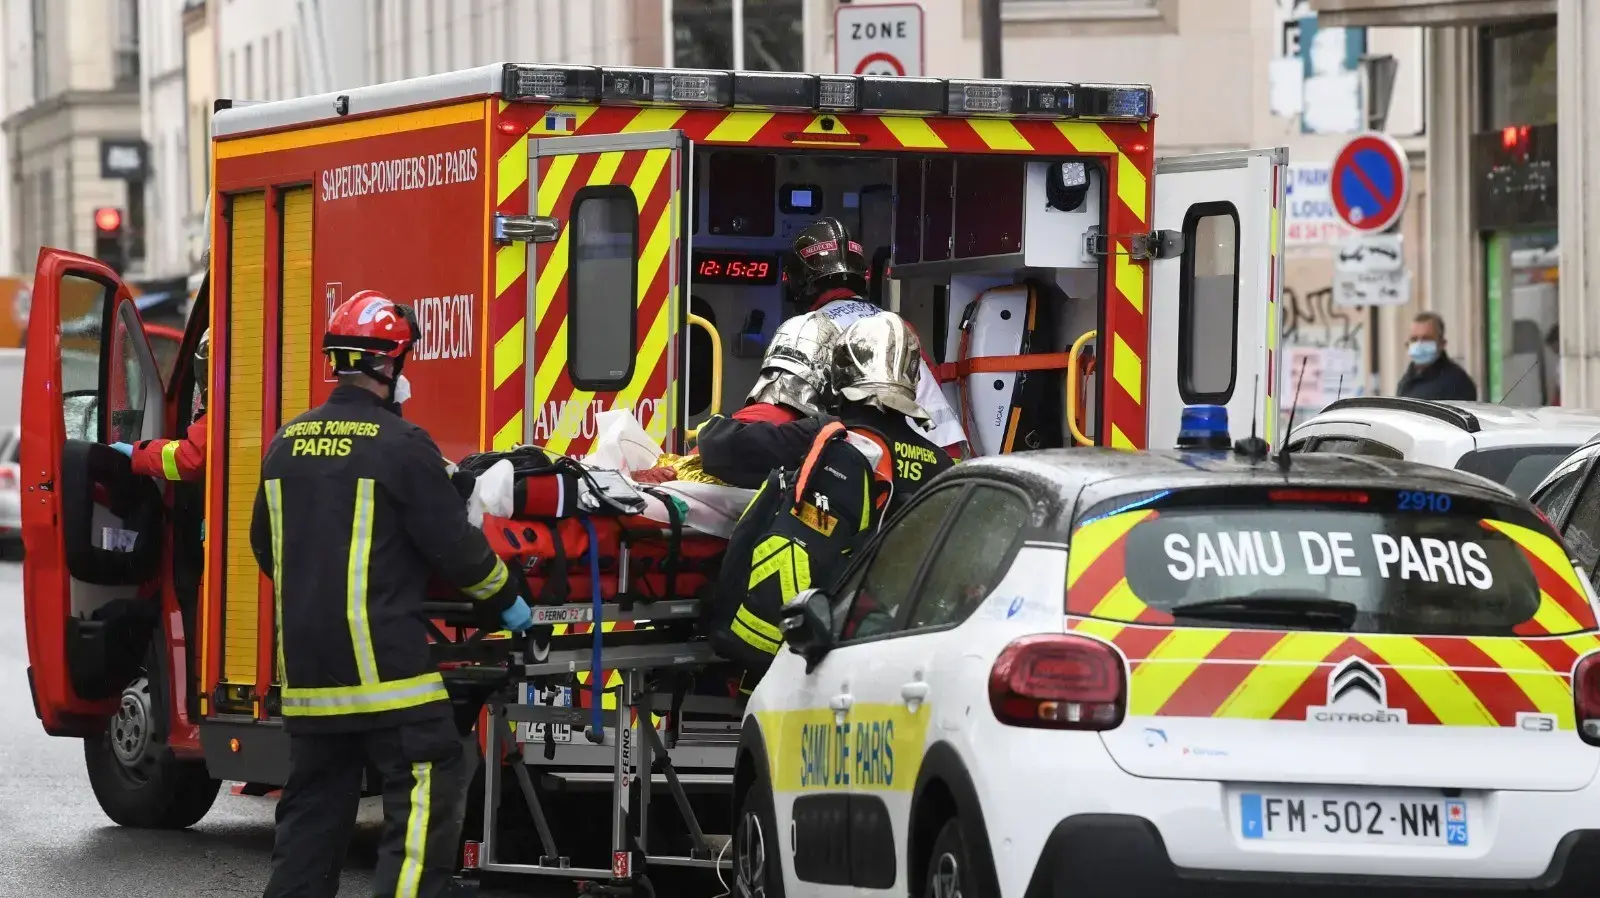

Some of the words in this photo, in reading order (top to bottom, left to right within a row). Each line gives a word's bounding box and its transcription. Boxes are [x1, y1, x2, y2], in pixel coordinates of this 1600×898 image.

[851, 21, 906, 40] ZONE
[322, 155, 426, 202] SAPEURS-POMPIERS
[427, 153, 443, 187] DE
[444, 147, 478, 184] PARIS
[805, 242, 834, 254] MEDECIN
[699, 260, 769, 277] 12:15:29
[412, 293, 474, 361] MEDECIN
[994, 405, 1005, 427] LUCAS
[282, 421, 323, 438] SAPEURS
[323, 420, 380, 437] POMPIERS
[291, 437, 353, 456] PARIS
[894, 441, 938, 465] POMPIERS
[1397, 492, 1452, 513] 2910
[1164, 530, 1286, 581] SAMU
[1298, 530, 1361, 577] DE
[1372, 533, 1494, 590] PARIS
[544, 610, 567, 621] FERNO
[564, 693, 571, 705] 75
[1521, 717, 1554, 732] C3
[622, 728, 630, 775] FERNO
[800, 723, 831, 788] SAMU
[834, 722, 850, 785] DE
[856, 718, 895, 786] PARIS
[1265, 798, 1440, 837] FM-502-NM
[1448, 824, 1467, 842] 75
